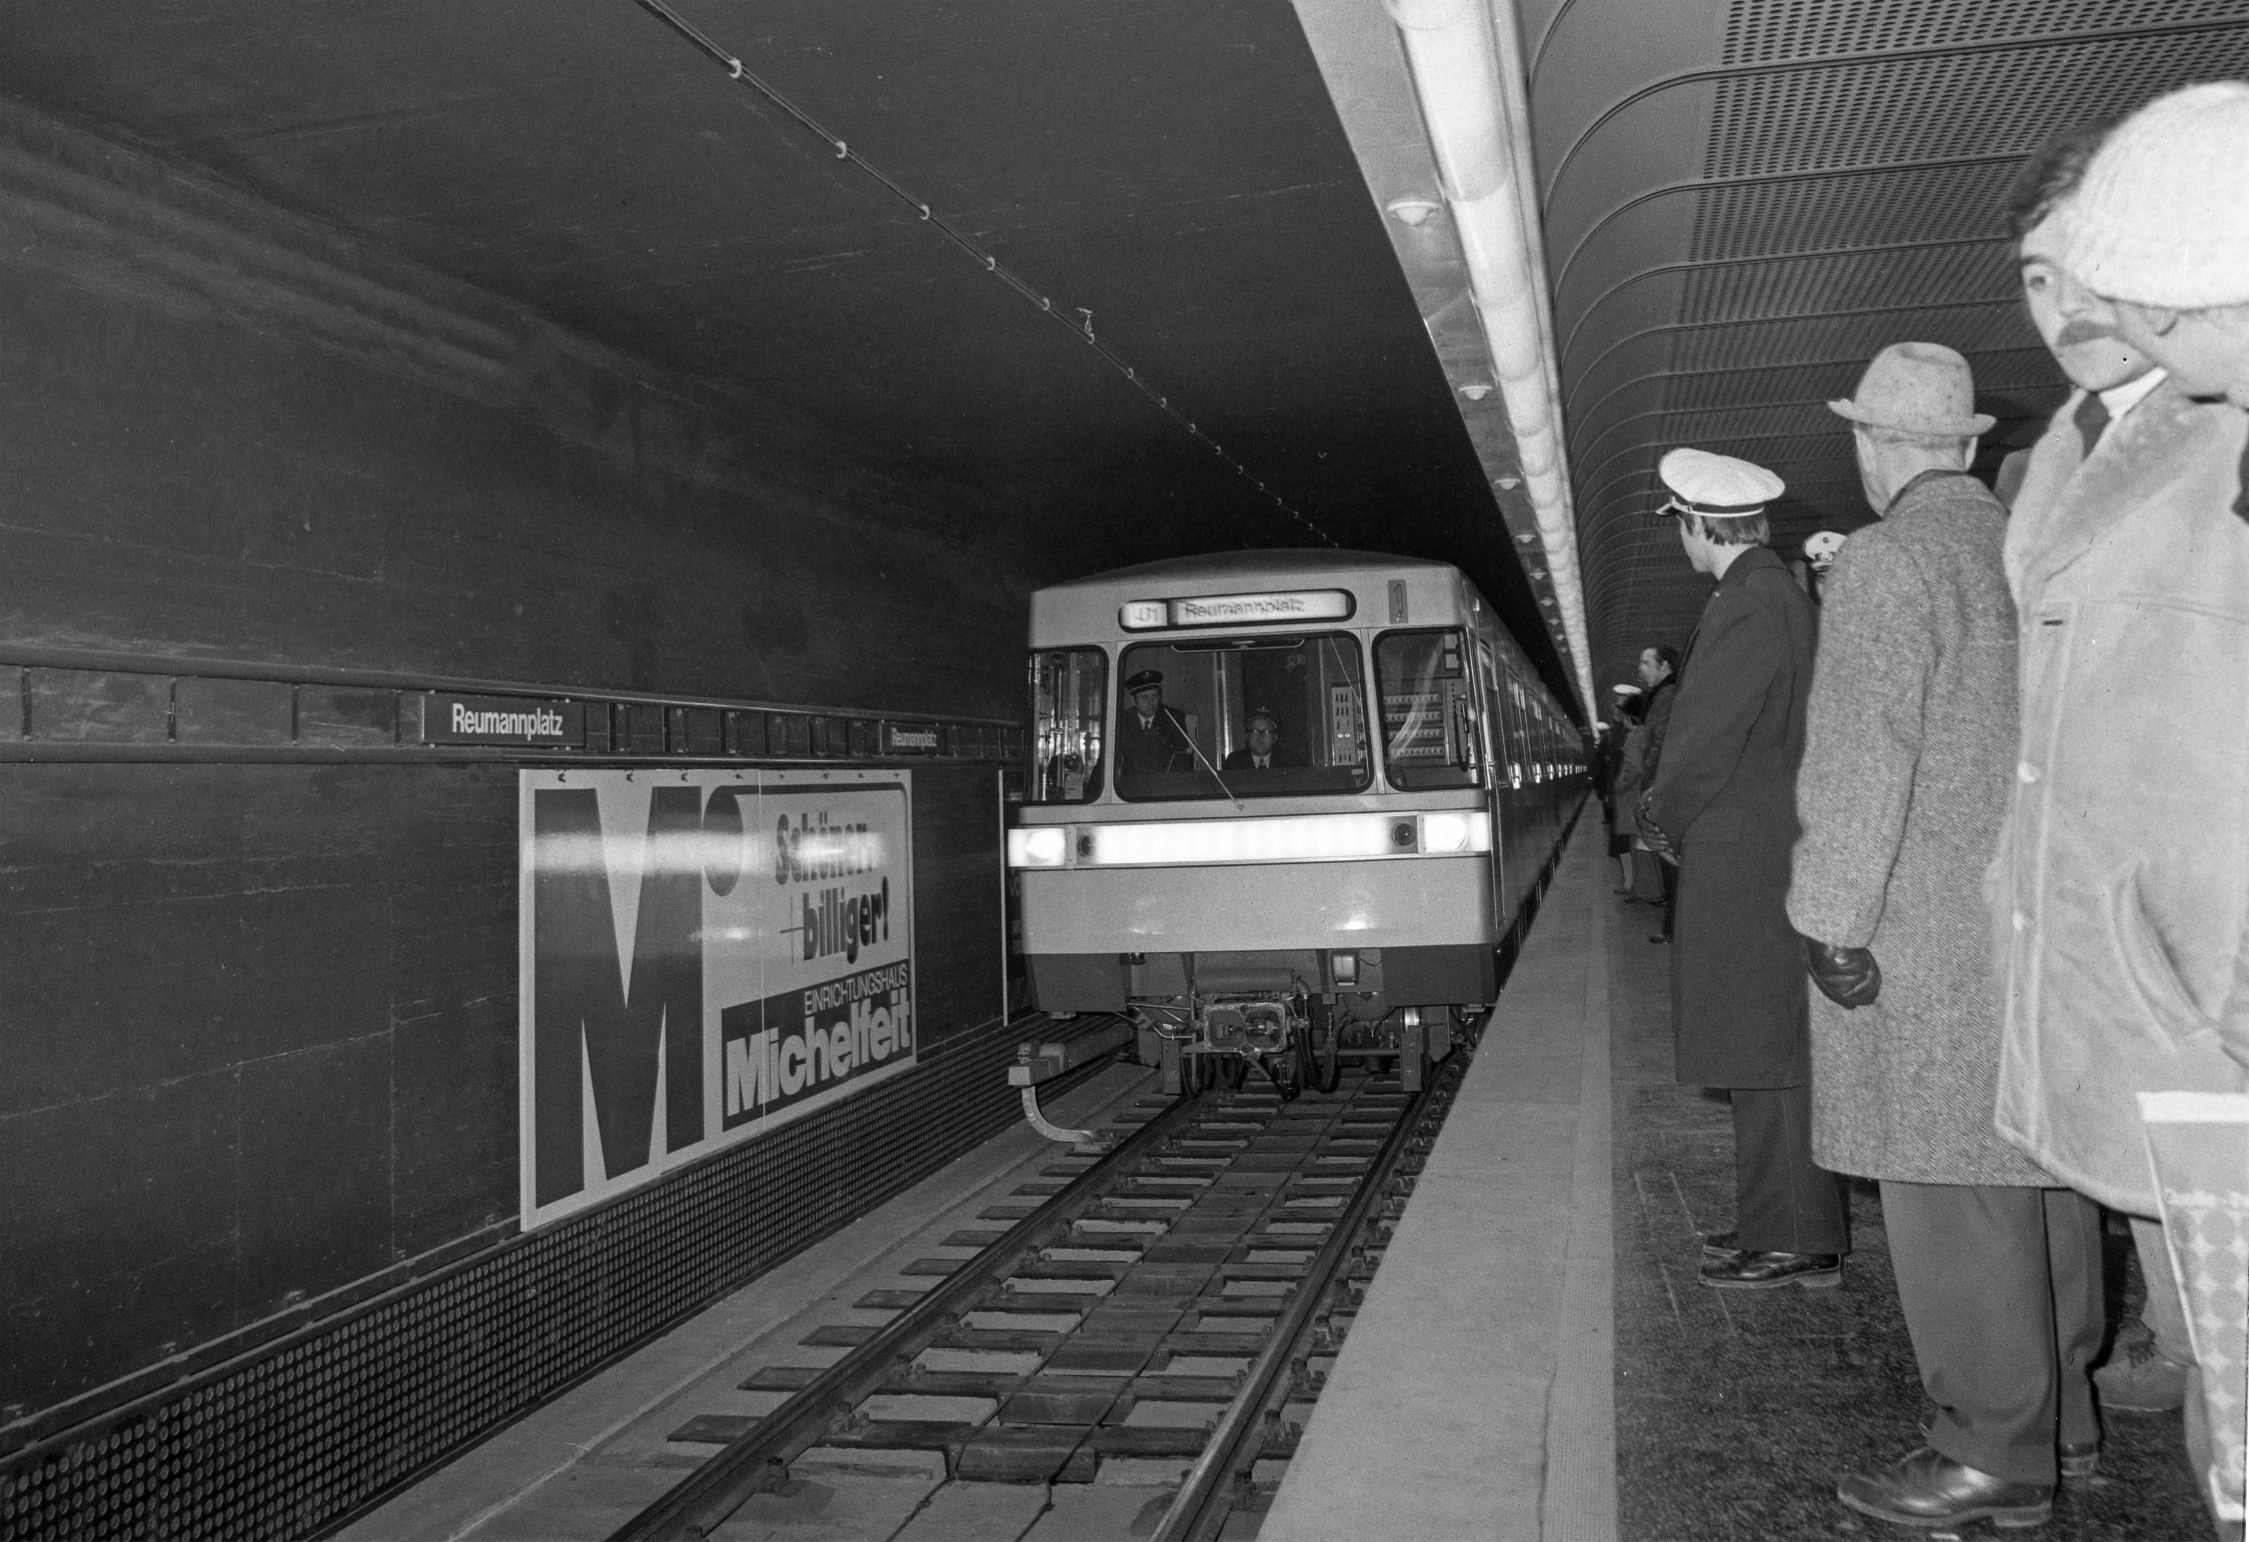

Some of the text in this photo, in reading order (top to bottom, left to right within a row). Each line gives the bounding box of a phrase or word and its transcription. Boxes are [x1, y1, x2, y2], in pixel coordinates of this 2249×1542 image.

[1185, 597, 1305, 618] Reumannplatz
[452, 702, 564, 742] Reumannplatz
[891, 727, 938, 751] Reumannplatz
[804, 963, 908, 1016] EINRICHTUNGSHAUS
[726, 987, 911, 1117] Michelfeit
